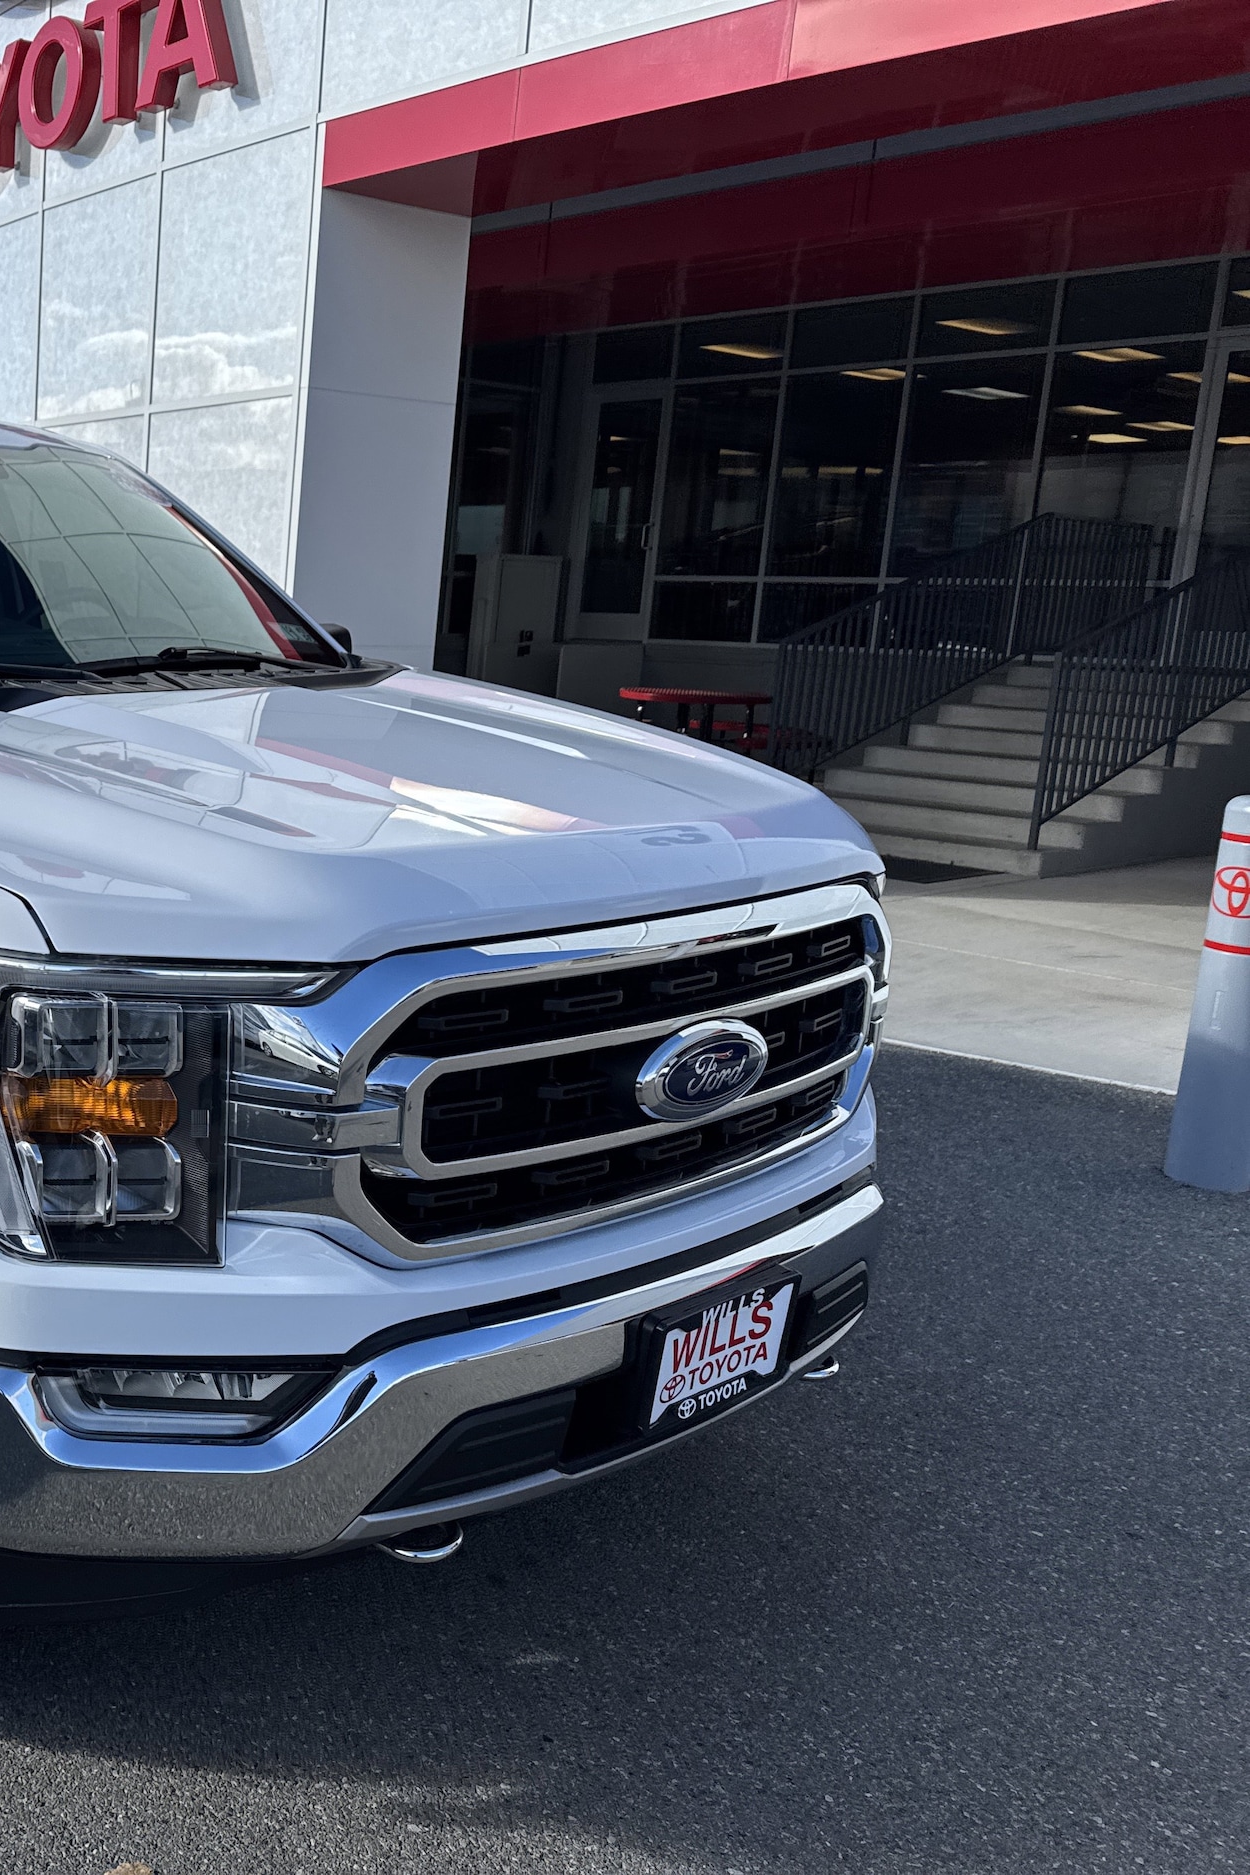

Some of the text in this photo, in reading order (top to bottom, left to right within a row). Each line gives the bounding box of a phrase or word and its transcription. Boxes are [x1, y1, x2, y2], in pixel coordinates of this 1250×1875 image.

[687, 1050, 747, 1096] Ford
[702, 1288, 766, 1325] WILLS
[672, 1301, 774, 1374] WILLS
[688, 1341, 768, 1390] TOYOTA
[698, 1377, 747, 1410] TOYOTA
